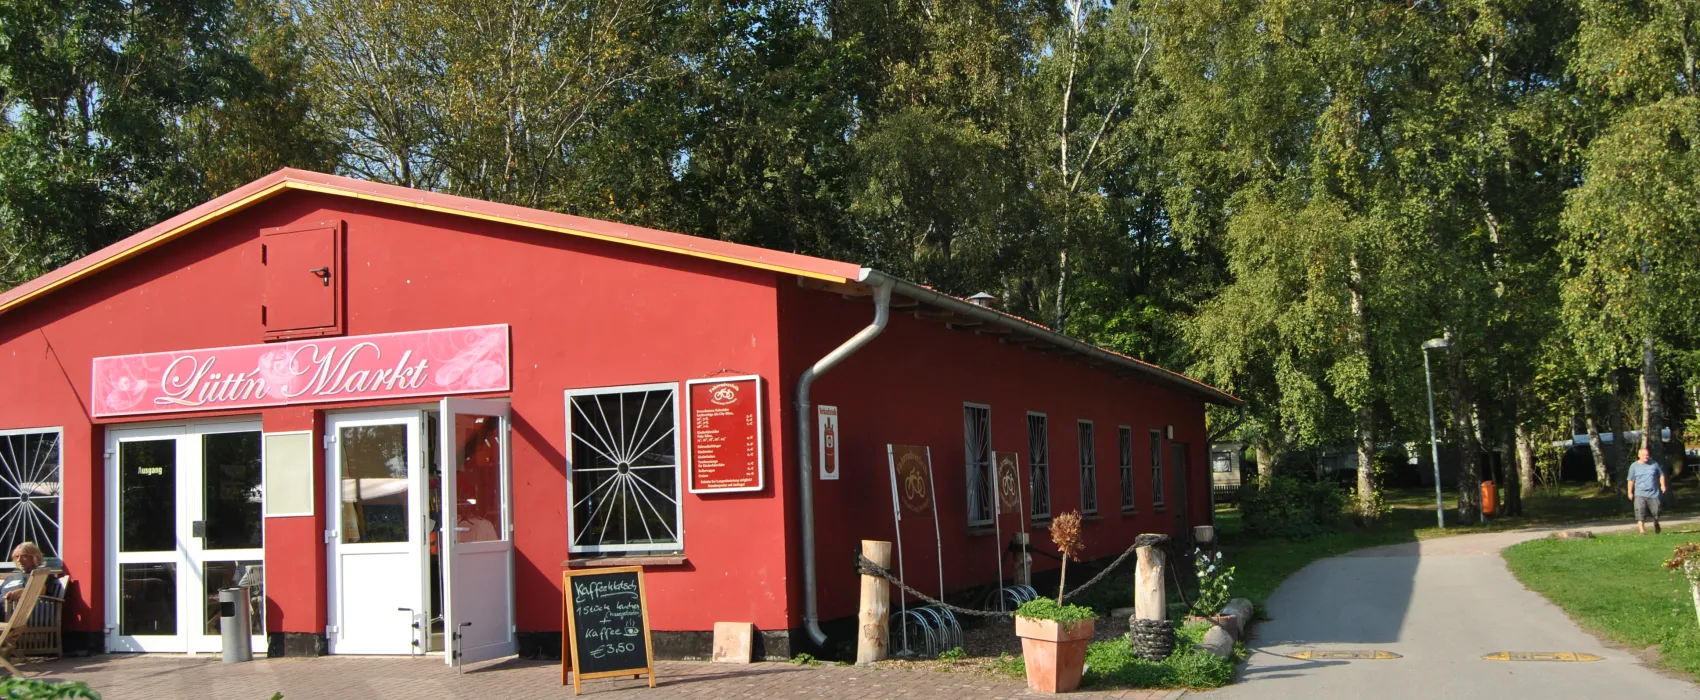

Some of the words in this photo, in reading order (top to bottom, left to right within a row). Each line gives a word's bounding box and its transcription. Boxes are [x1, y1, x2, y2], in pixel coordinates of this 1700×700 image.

[281, 342, 428, 397] Markt
[138, 466, 163, 476] Ausgang
[585, 627, 622, 640] Kaffee
